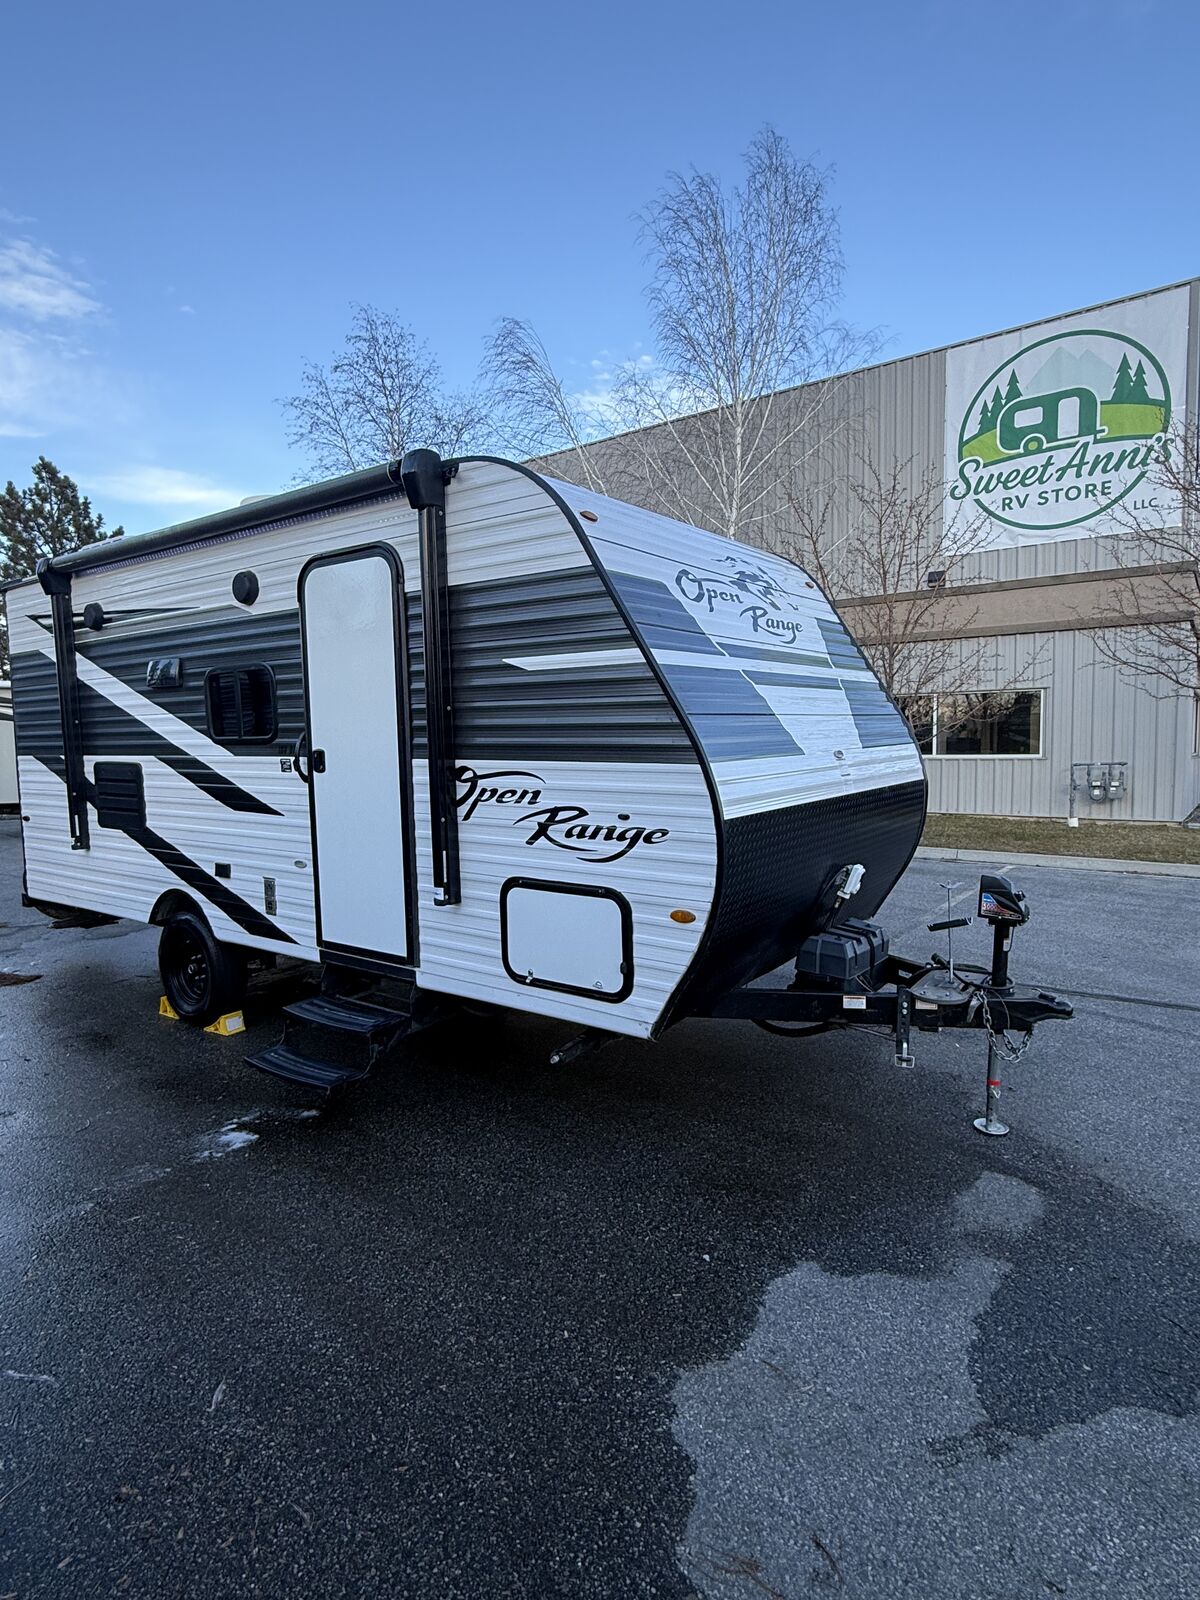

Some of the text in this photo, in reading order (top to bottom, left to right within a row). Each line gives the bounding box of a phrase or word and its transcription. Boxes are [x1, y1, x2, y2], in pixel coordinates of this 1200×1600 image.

[950, 455, 1054, 501] Sweet
[1001, 480, 1112, 512] RV STORE
[1133, 497, 1158, 510] LLC
[675, 568, 744, 613] Open
[739, 605, 803, 645] Range
[453, 765, 546, 821] Open
[513, 806, 670, 863] Range
